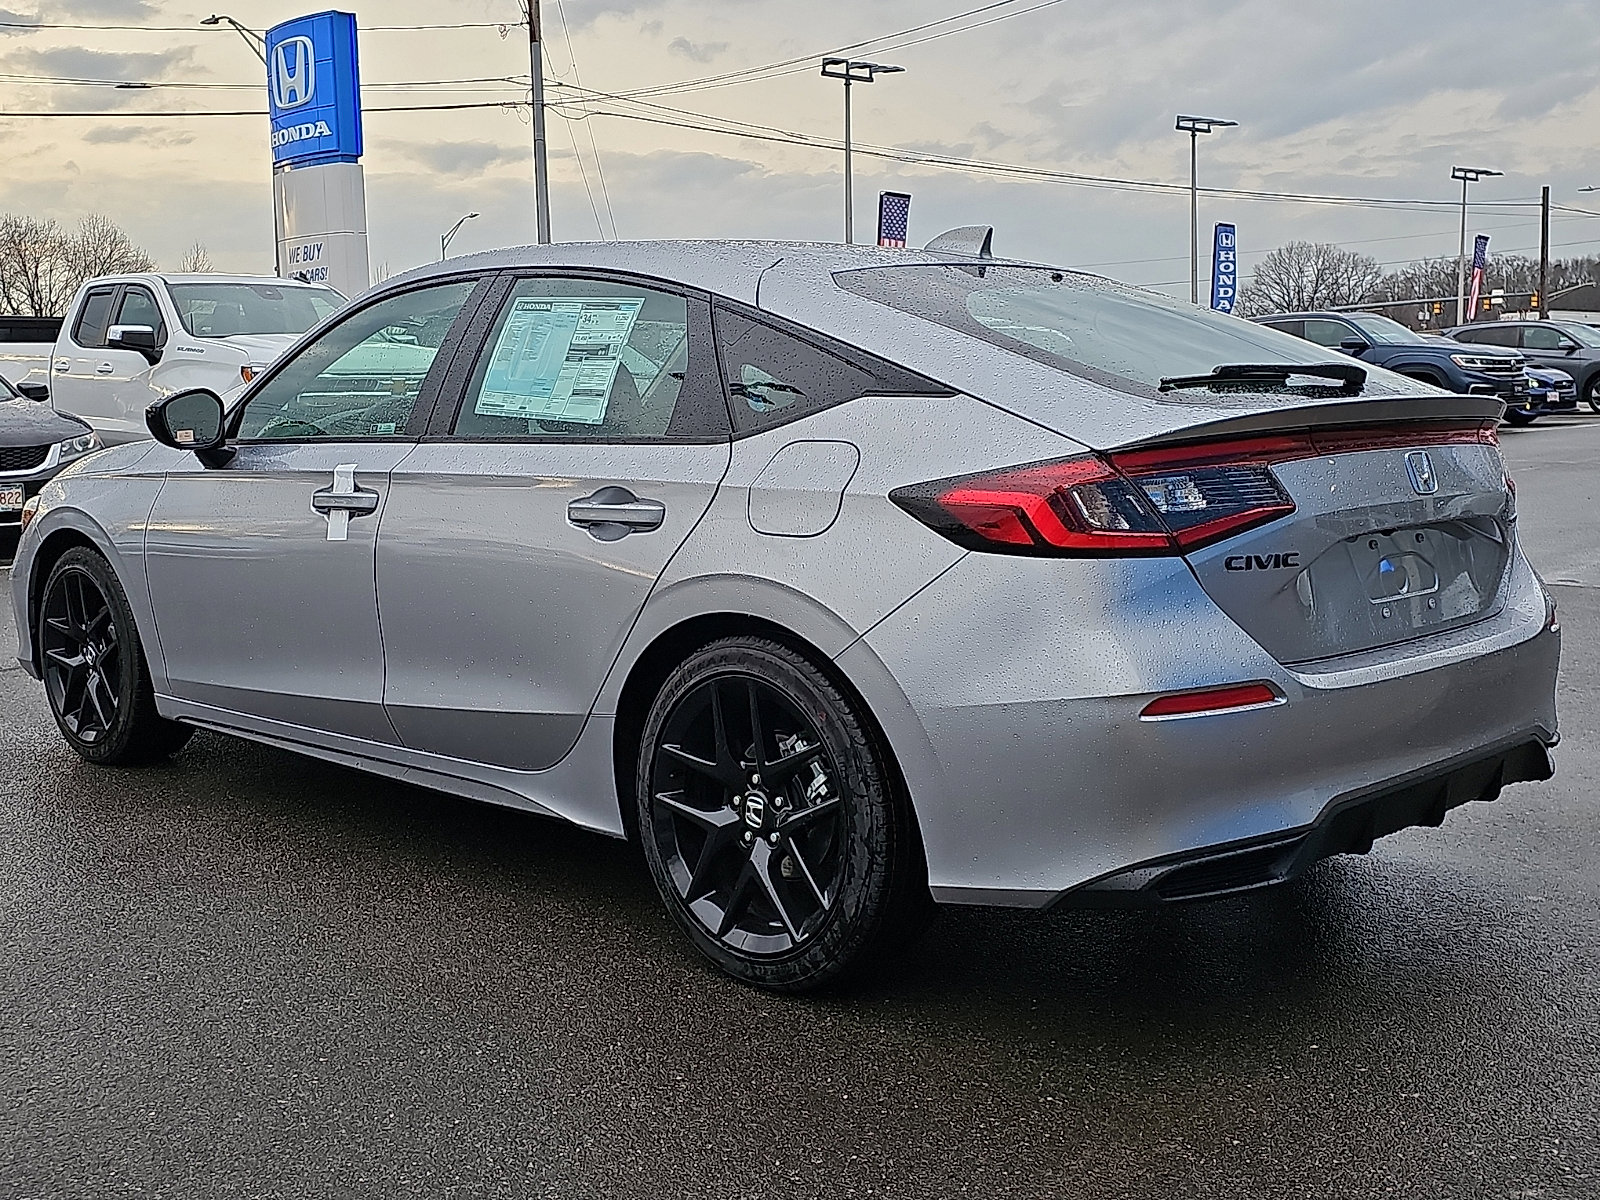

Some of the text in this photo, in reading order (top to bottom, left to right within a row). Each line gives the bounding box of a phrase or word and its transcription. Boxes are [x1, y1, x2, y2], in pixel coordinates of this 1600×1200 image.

[271, 120, 333, 148] HONDA
[288, 243, 323, 264] WE BUY
[1216, 250, 1235, 310] HONDA
[1224, 552, 1300, 572] CIVIC
